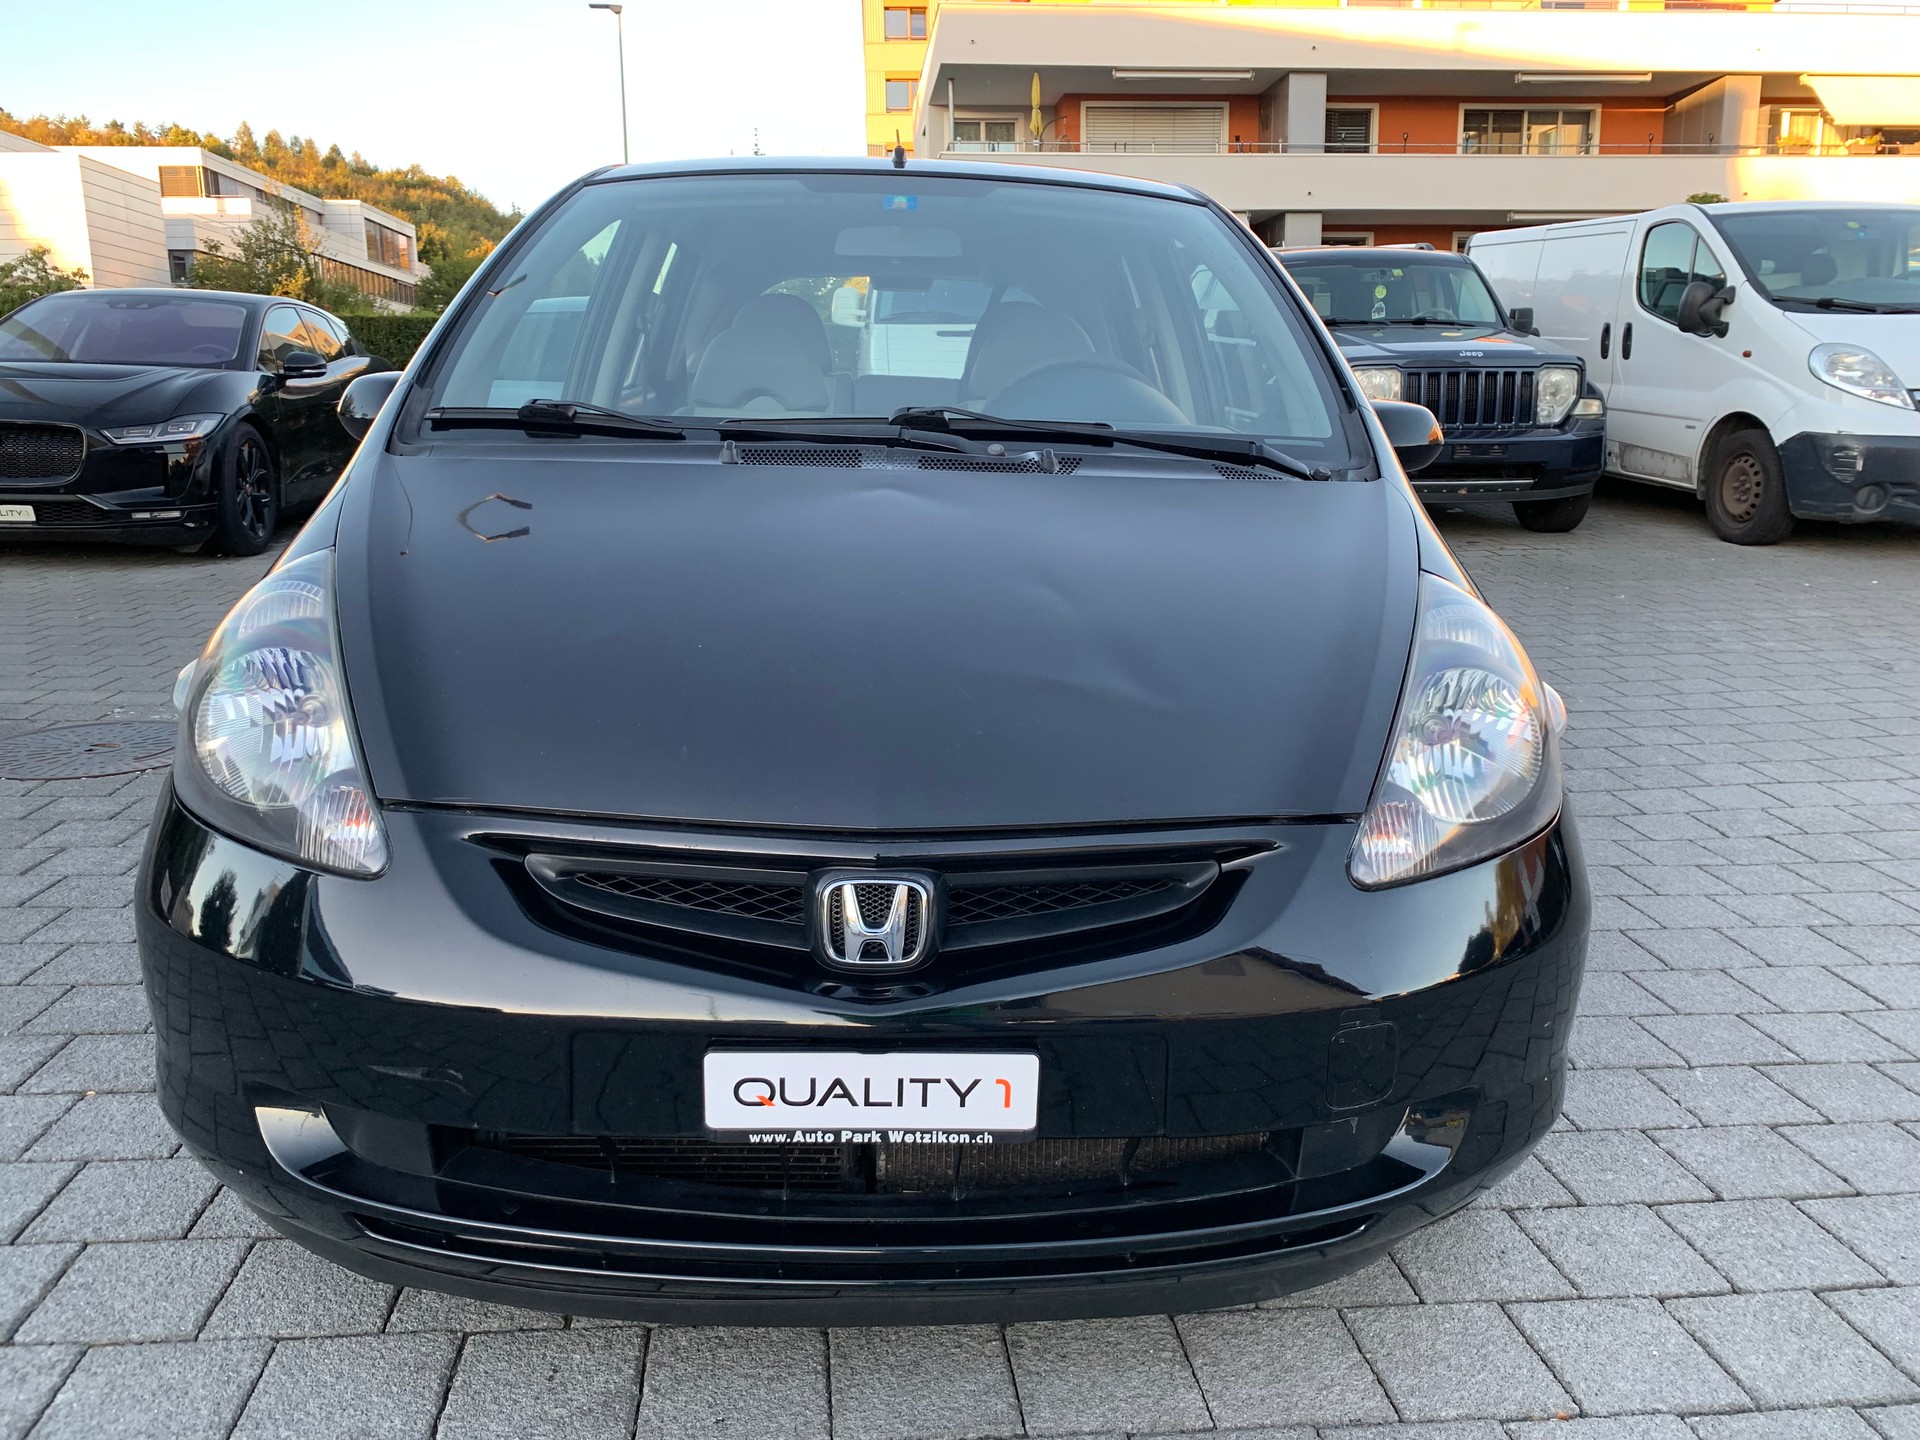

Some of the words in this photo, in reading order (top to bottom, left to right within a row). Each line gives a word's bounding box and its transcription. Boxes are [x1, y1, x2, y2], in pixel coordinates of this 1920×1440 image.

[1459, 350, 1484, 358] Jeep
[733, 1077, 982, 1108] QUALITY
[995, 1078, 1012, 1108] 1
[841, 1130, 882, 1143] Park
[888, 1130, 993, 1144] Wetzikon.ch
